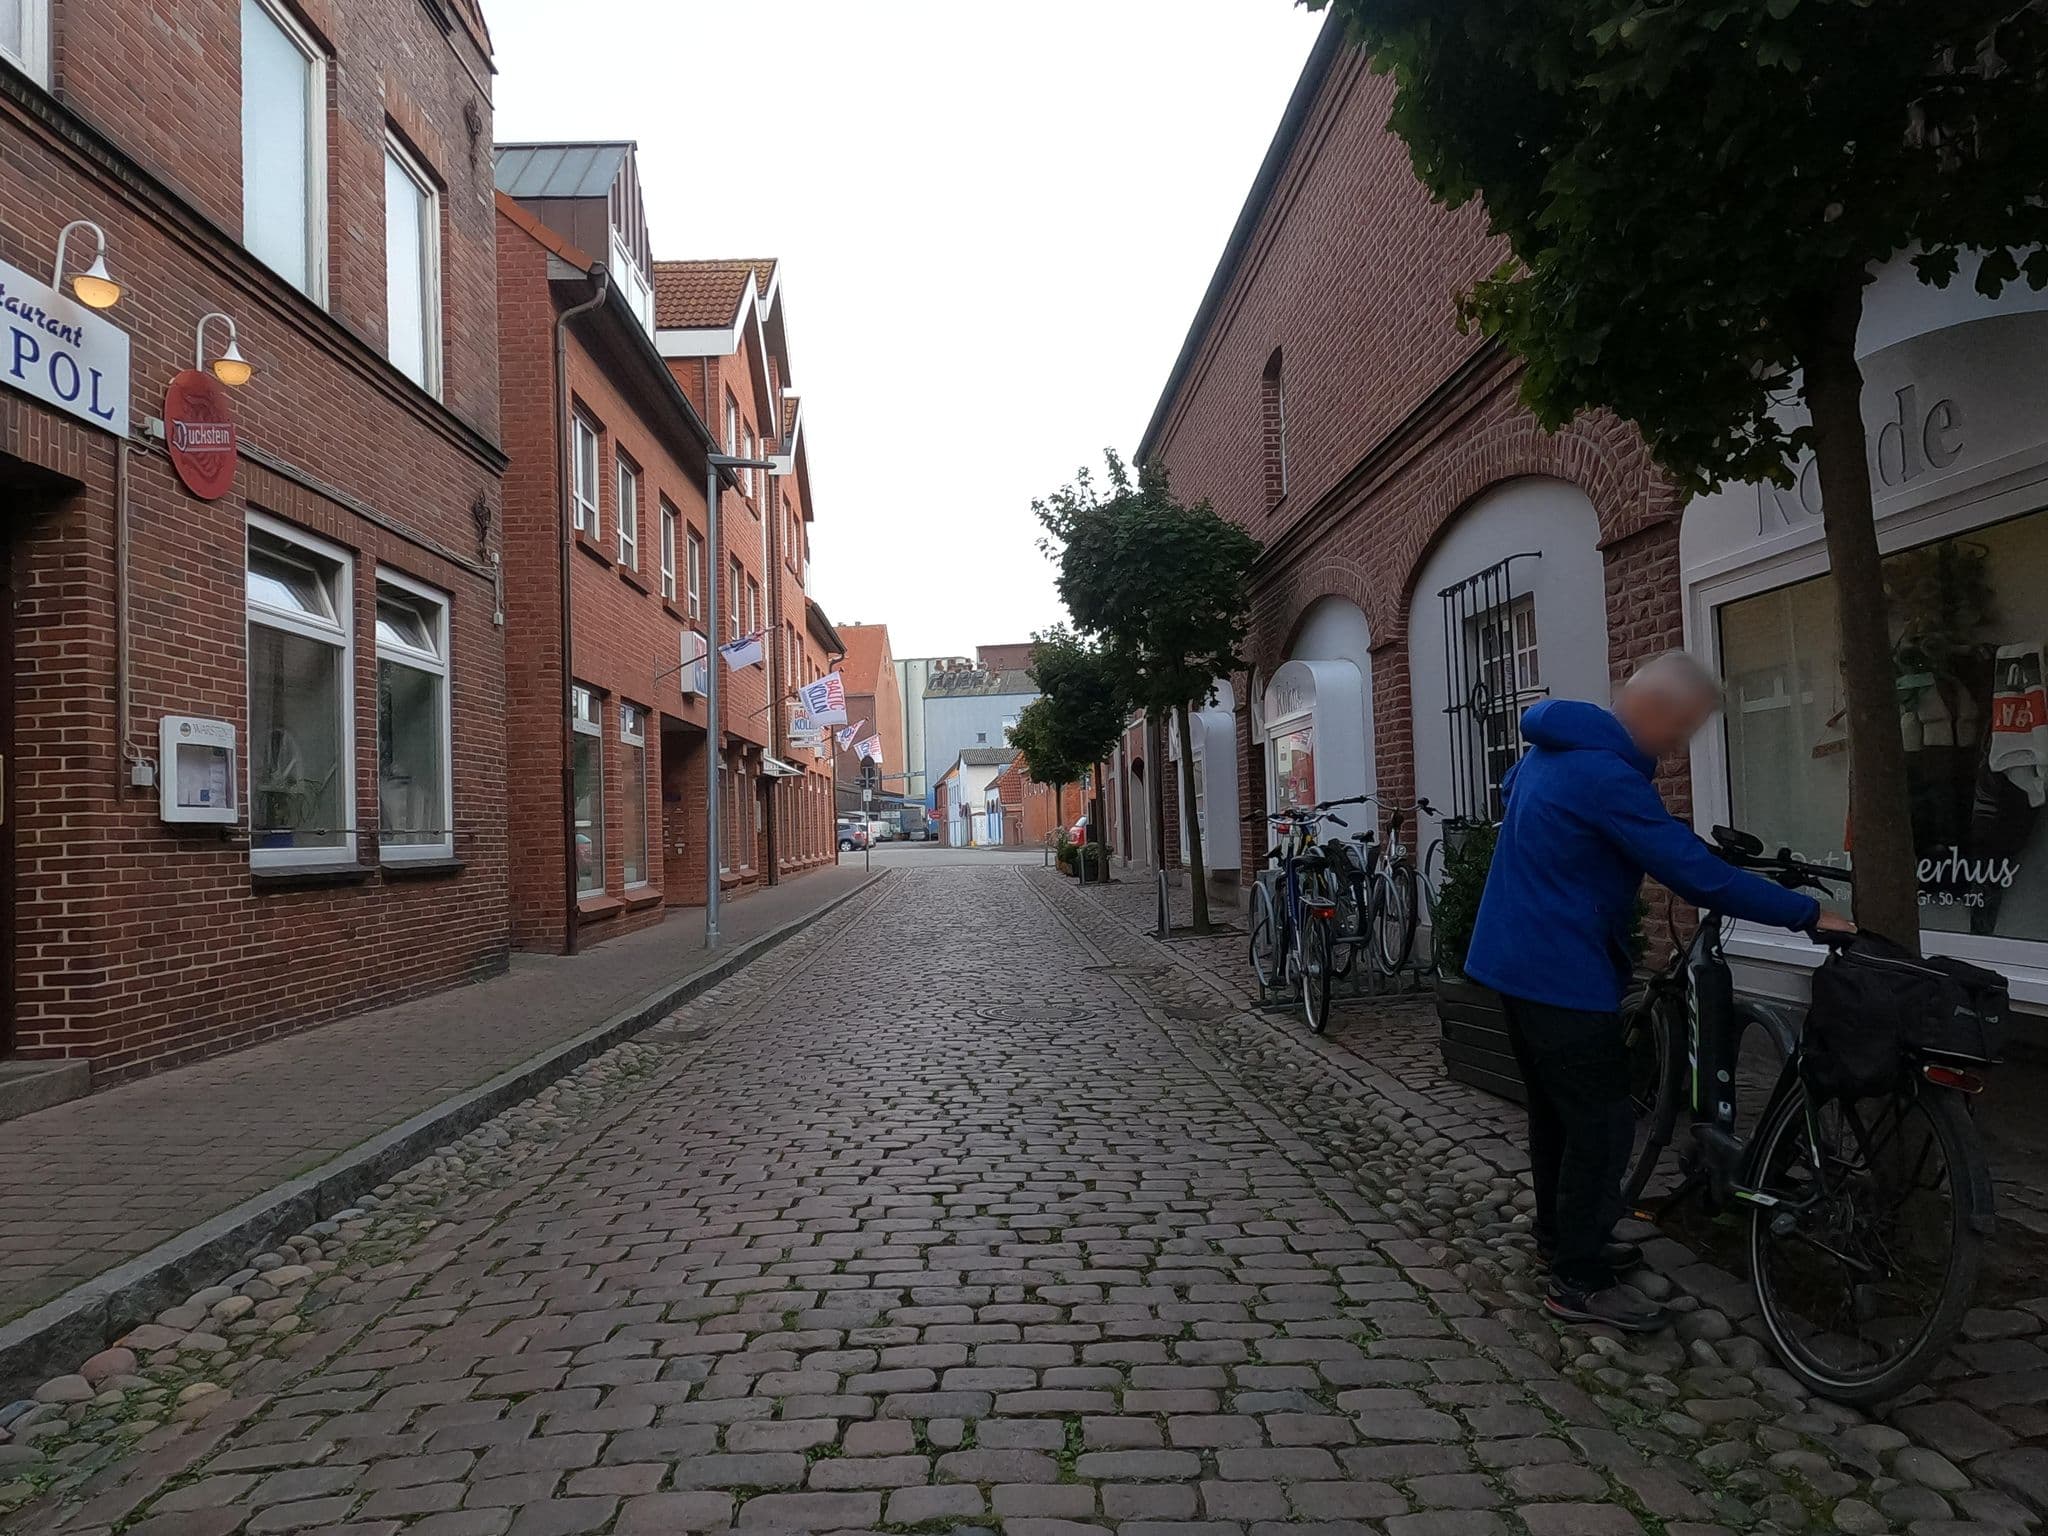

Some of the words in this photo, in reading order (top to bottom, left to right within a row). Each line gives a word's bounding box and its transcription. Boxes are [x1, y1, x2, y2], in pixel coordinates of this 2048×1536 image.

[9, 326, 115, 421] POL
[172, 420, 231, 452] Duckstein
[825, 679, 845, 711] BALTIC
[1916, 845, 2020, 888] erhus
[1938, 891, 1954, 906] 50
[1964, 891, 1985, 907] 176
